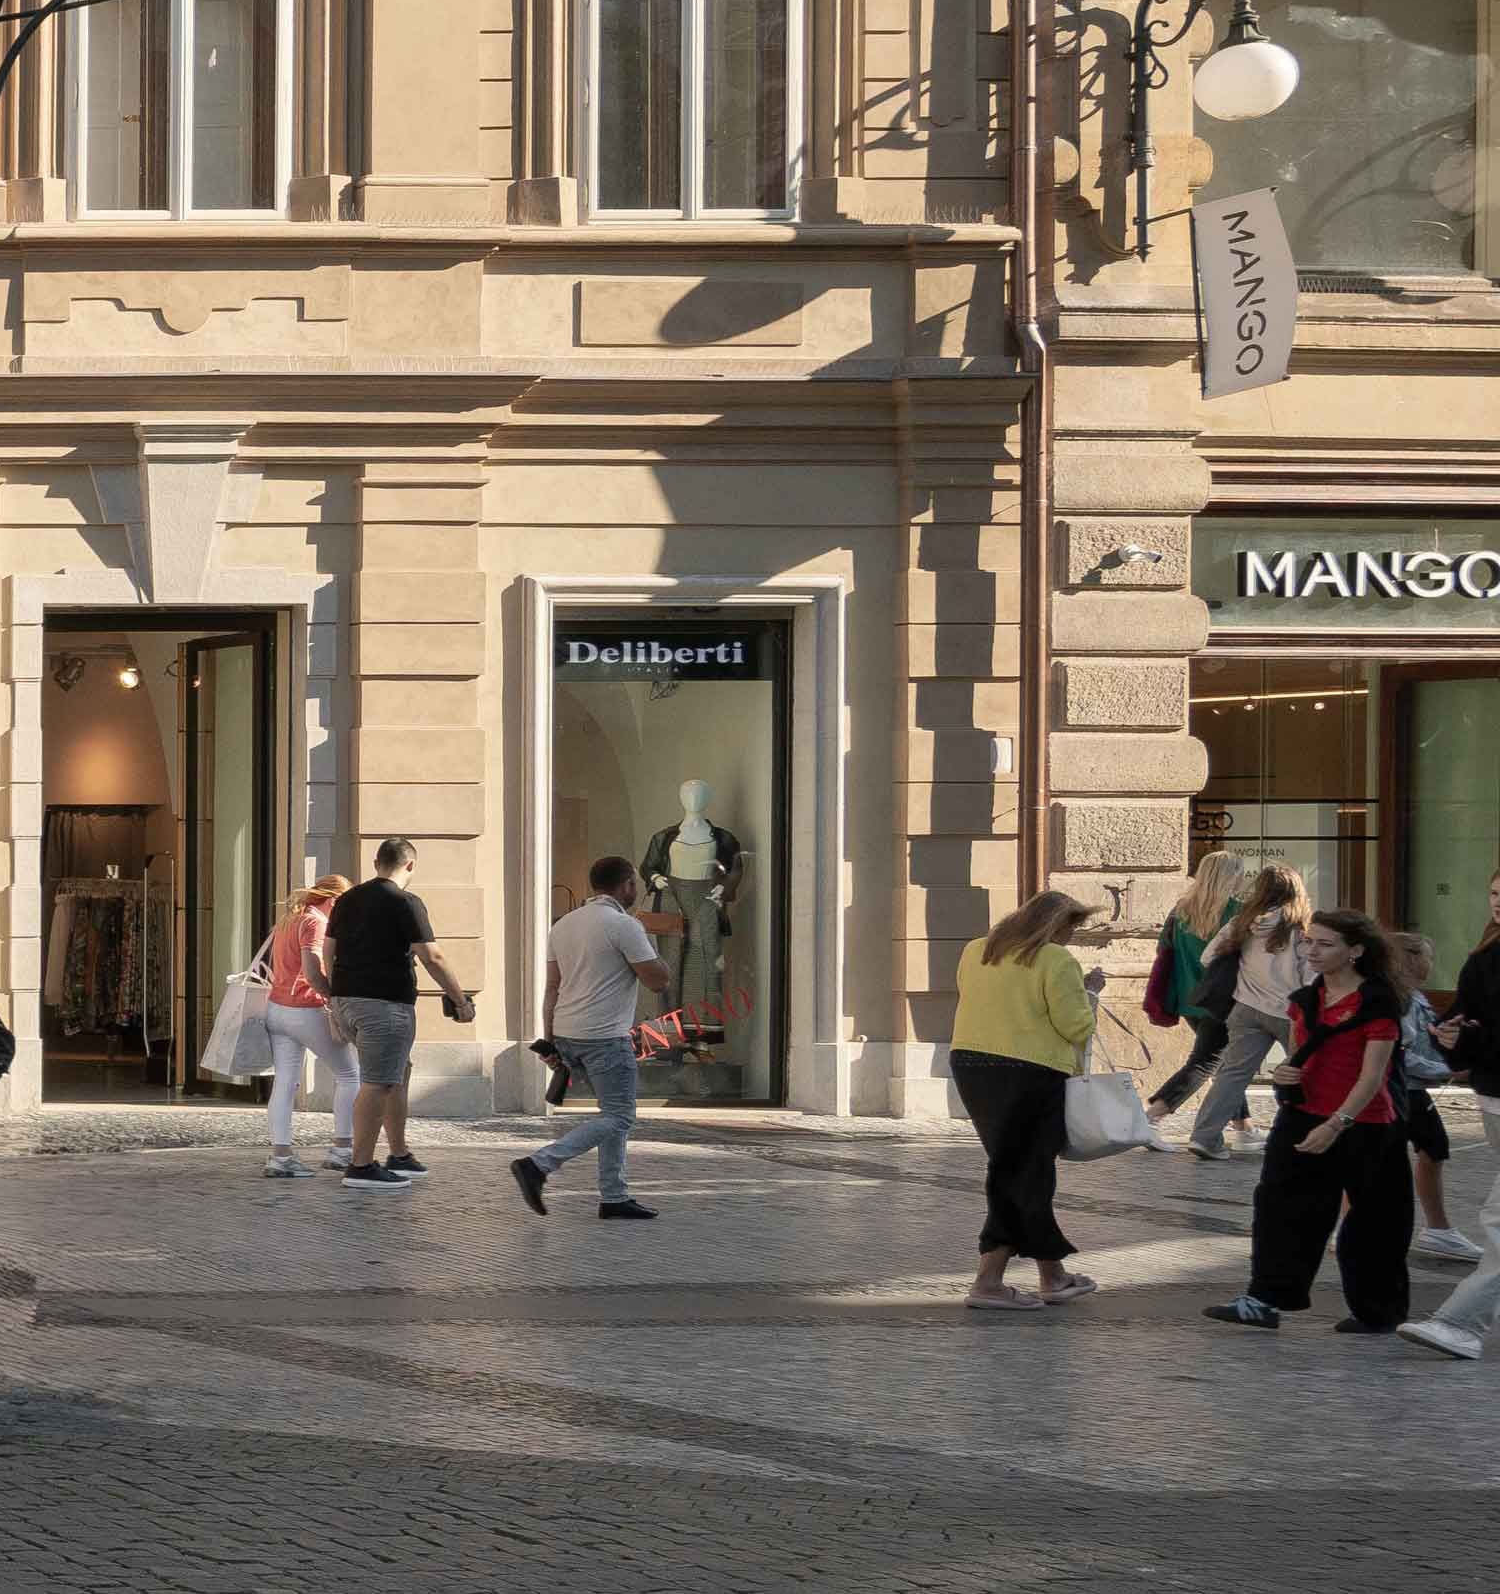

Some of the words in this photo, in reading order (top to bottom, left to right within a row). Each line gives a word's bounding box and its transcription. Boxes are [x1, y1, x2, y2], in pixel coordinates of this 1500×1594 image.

[1221, 210, 1267, 376] MANGO
[1242, 550, 1500, 599] MANGO
[565, 641, 745, 664] Deliberti
[627, 666, 680, 674] ITALIA
[1234, 848, 1285, 857] WOMAN
